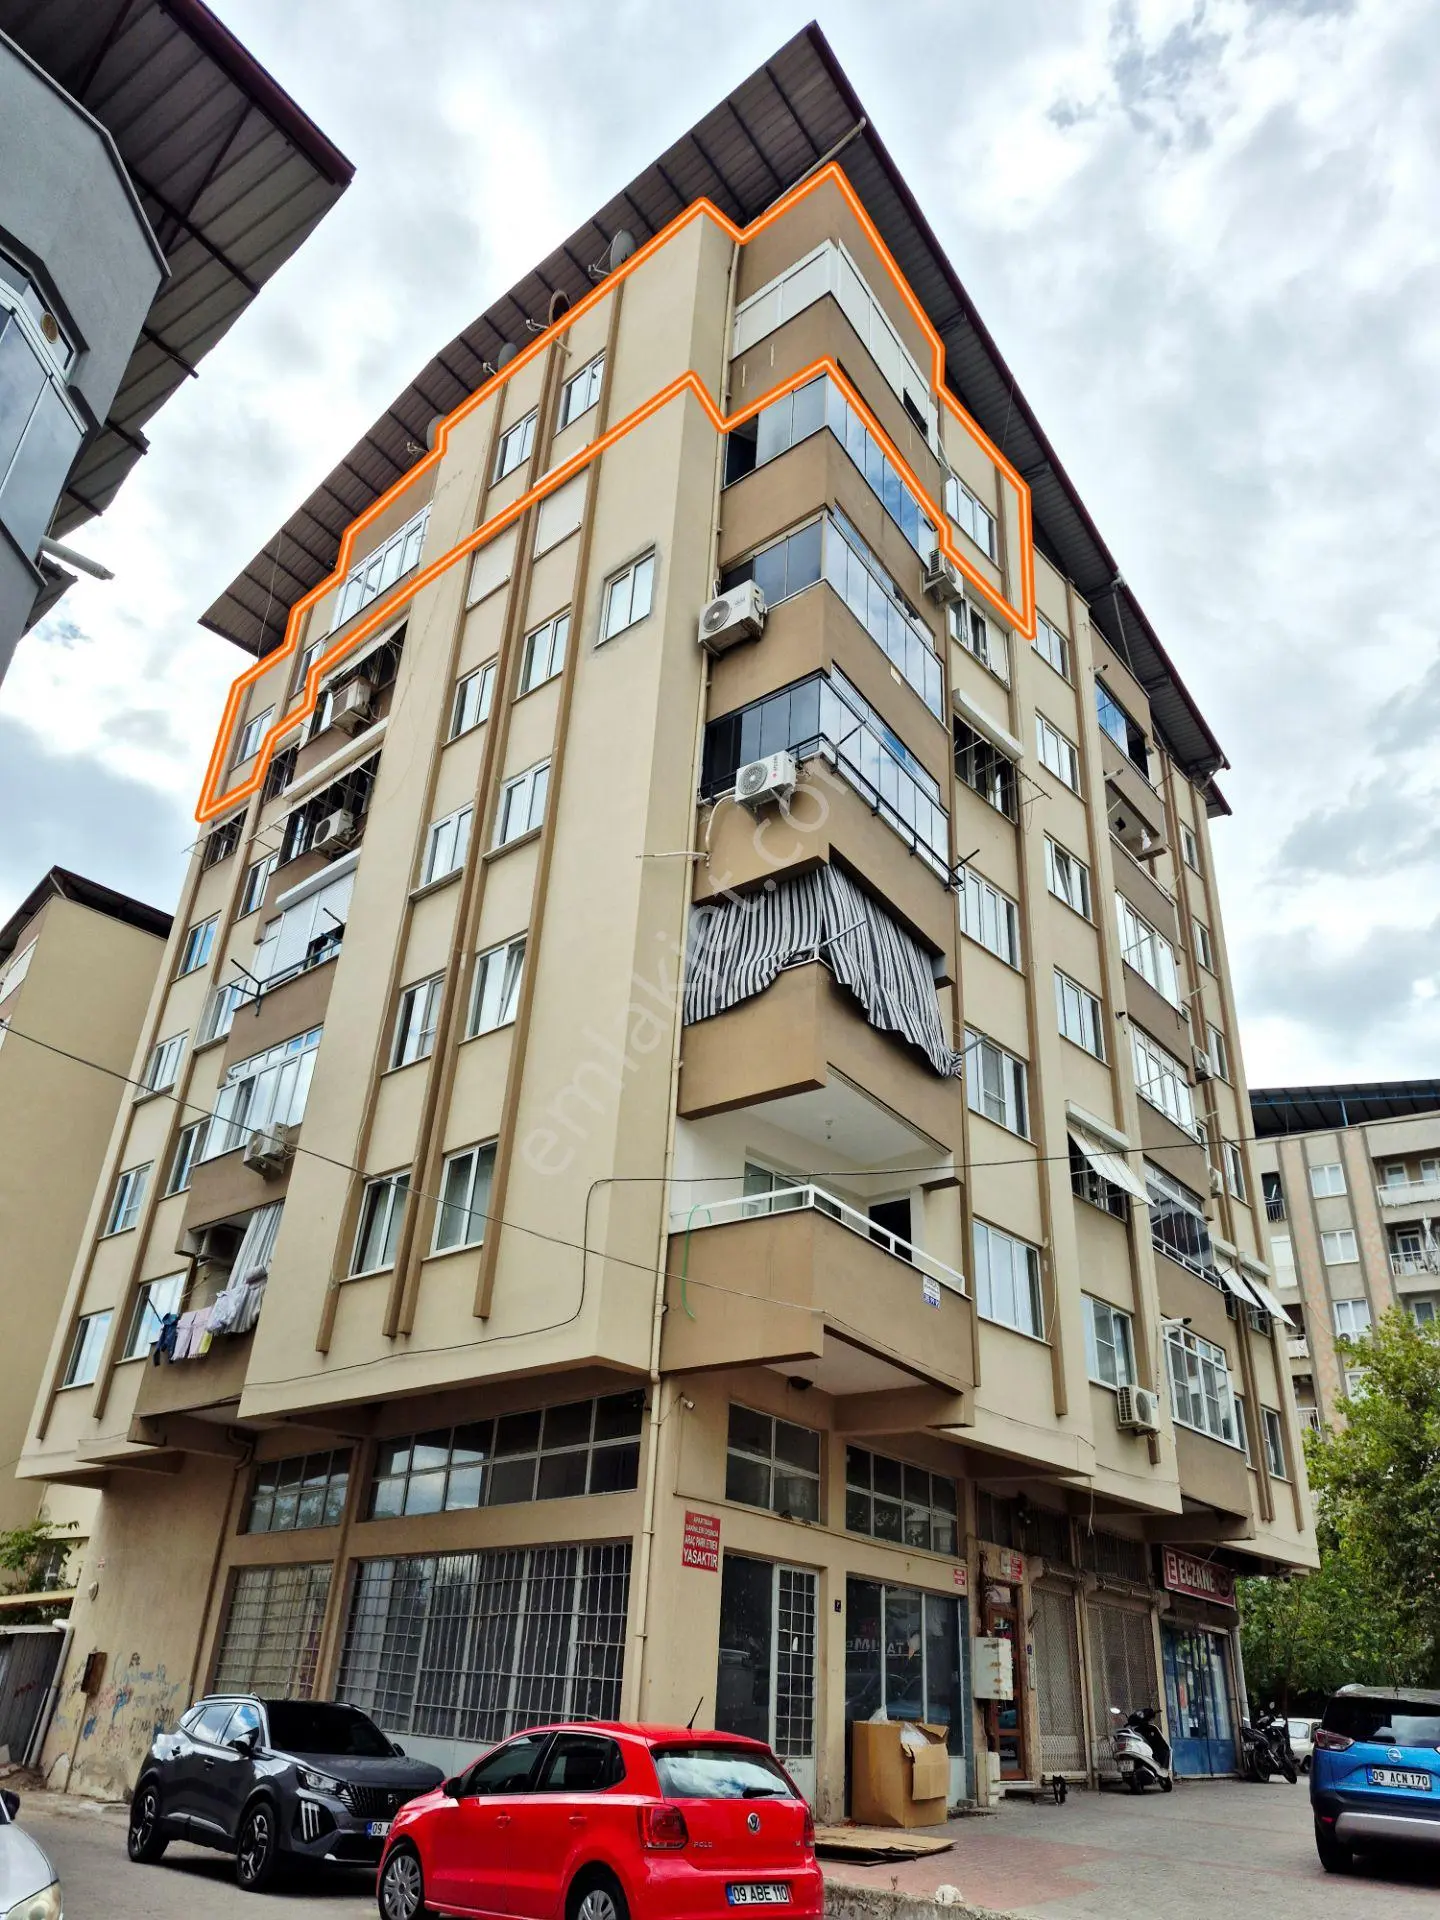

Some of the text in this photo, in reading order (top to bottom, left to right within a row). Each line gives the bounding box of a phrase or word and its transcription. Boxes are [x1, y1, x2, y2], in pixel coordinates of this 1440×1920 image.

[683, 1548, 718, 1568] YASAKTIR
[1178, 1558, 1216, 1593] ECZANE
[1372, 1770, 1428, 1786] 09 ACN 170
[372, 1822, 383, 1835] 09
[732, 1885, 788, 1902] 09 ABE 110
